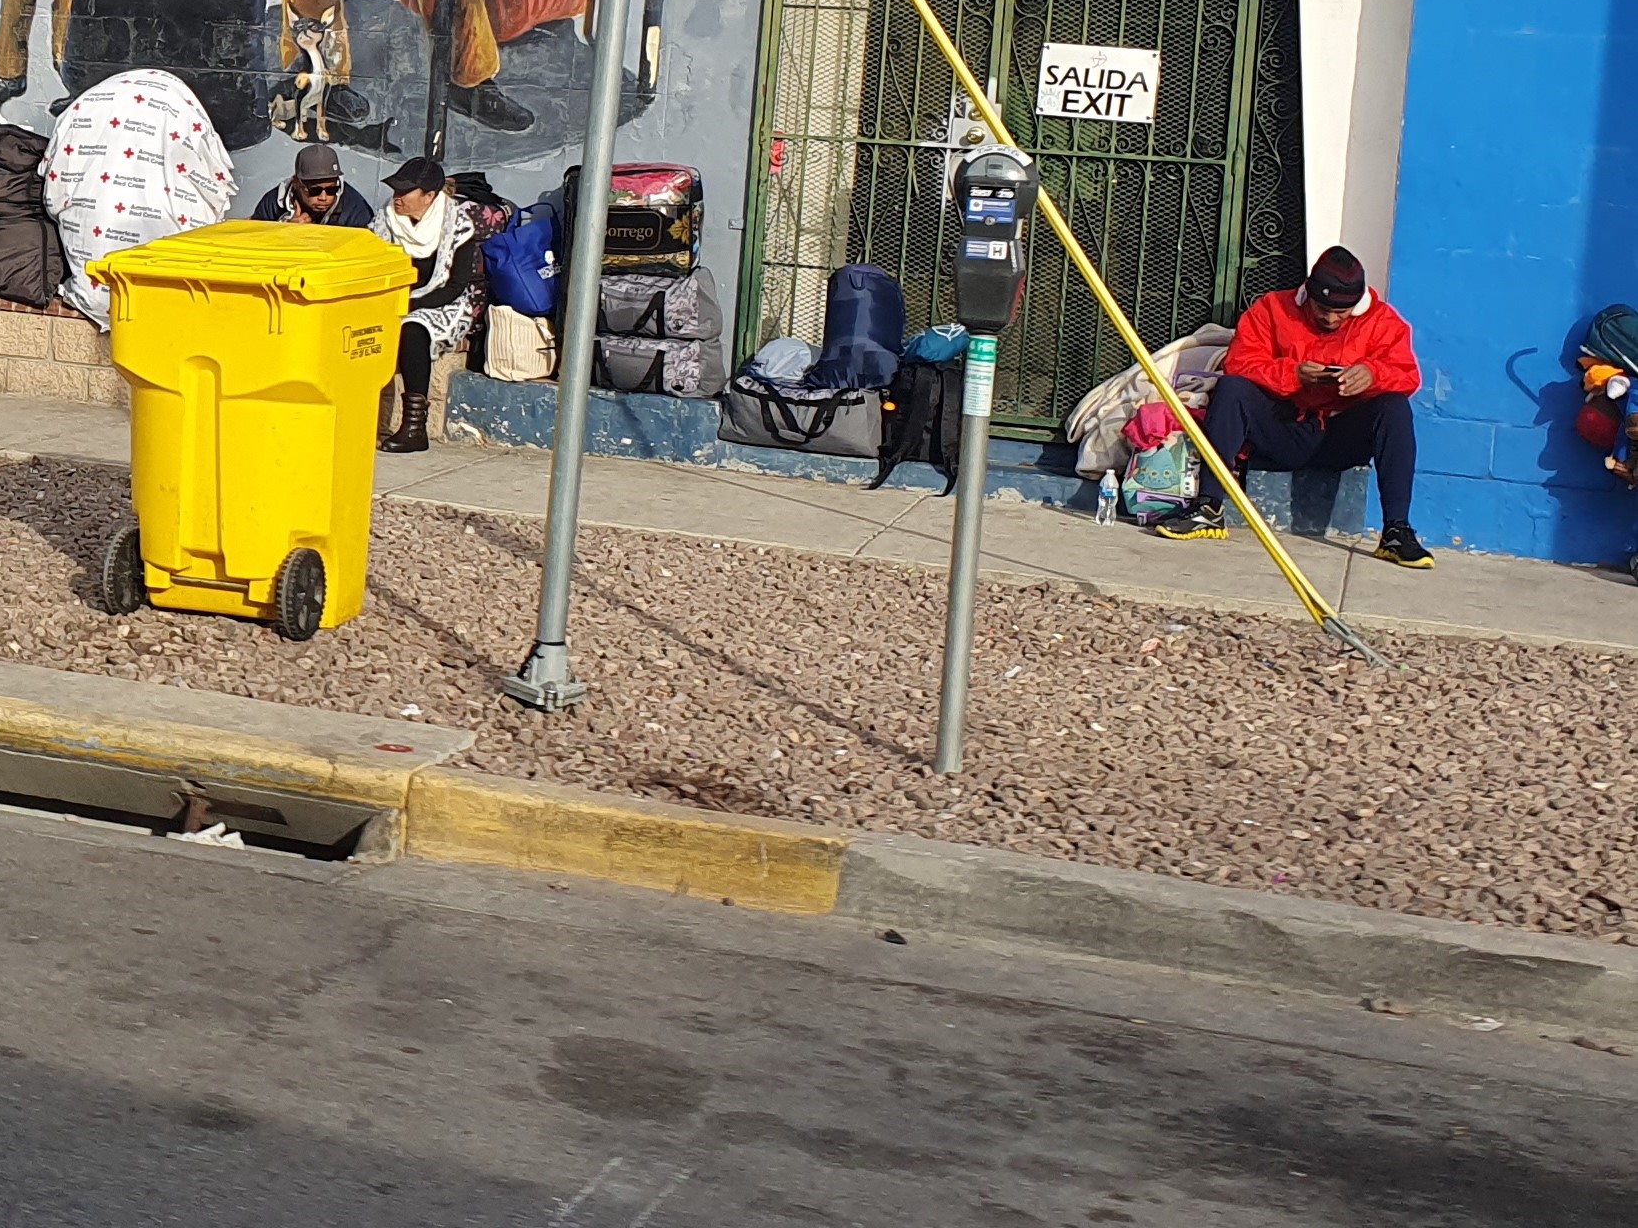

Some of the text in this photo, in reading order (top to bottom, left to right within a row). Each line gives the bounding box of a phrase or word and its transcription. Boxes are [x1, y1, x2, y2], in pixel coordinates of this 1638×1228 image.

[1044, 65, 1149, 92] SALIDA
[1061, 89, 1133, 117] EXIT
[105, 227, 140, 237] American
[604, 226, 654, 241] orrego
